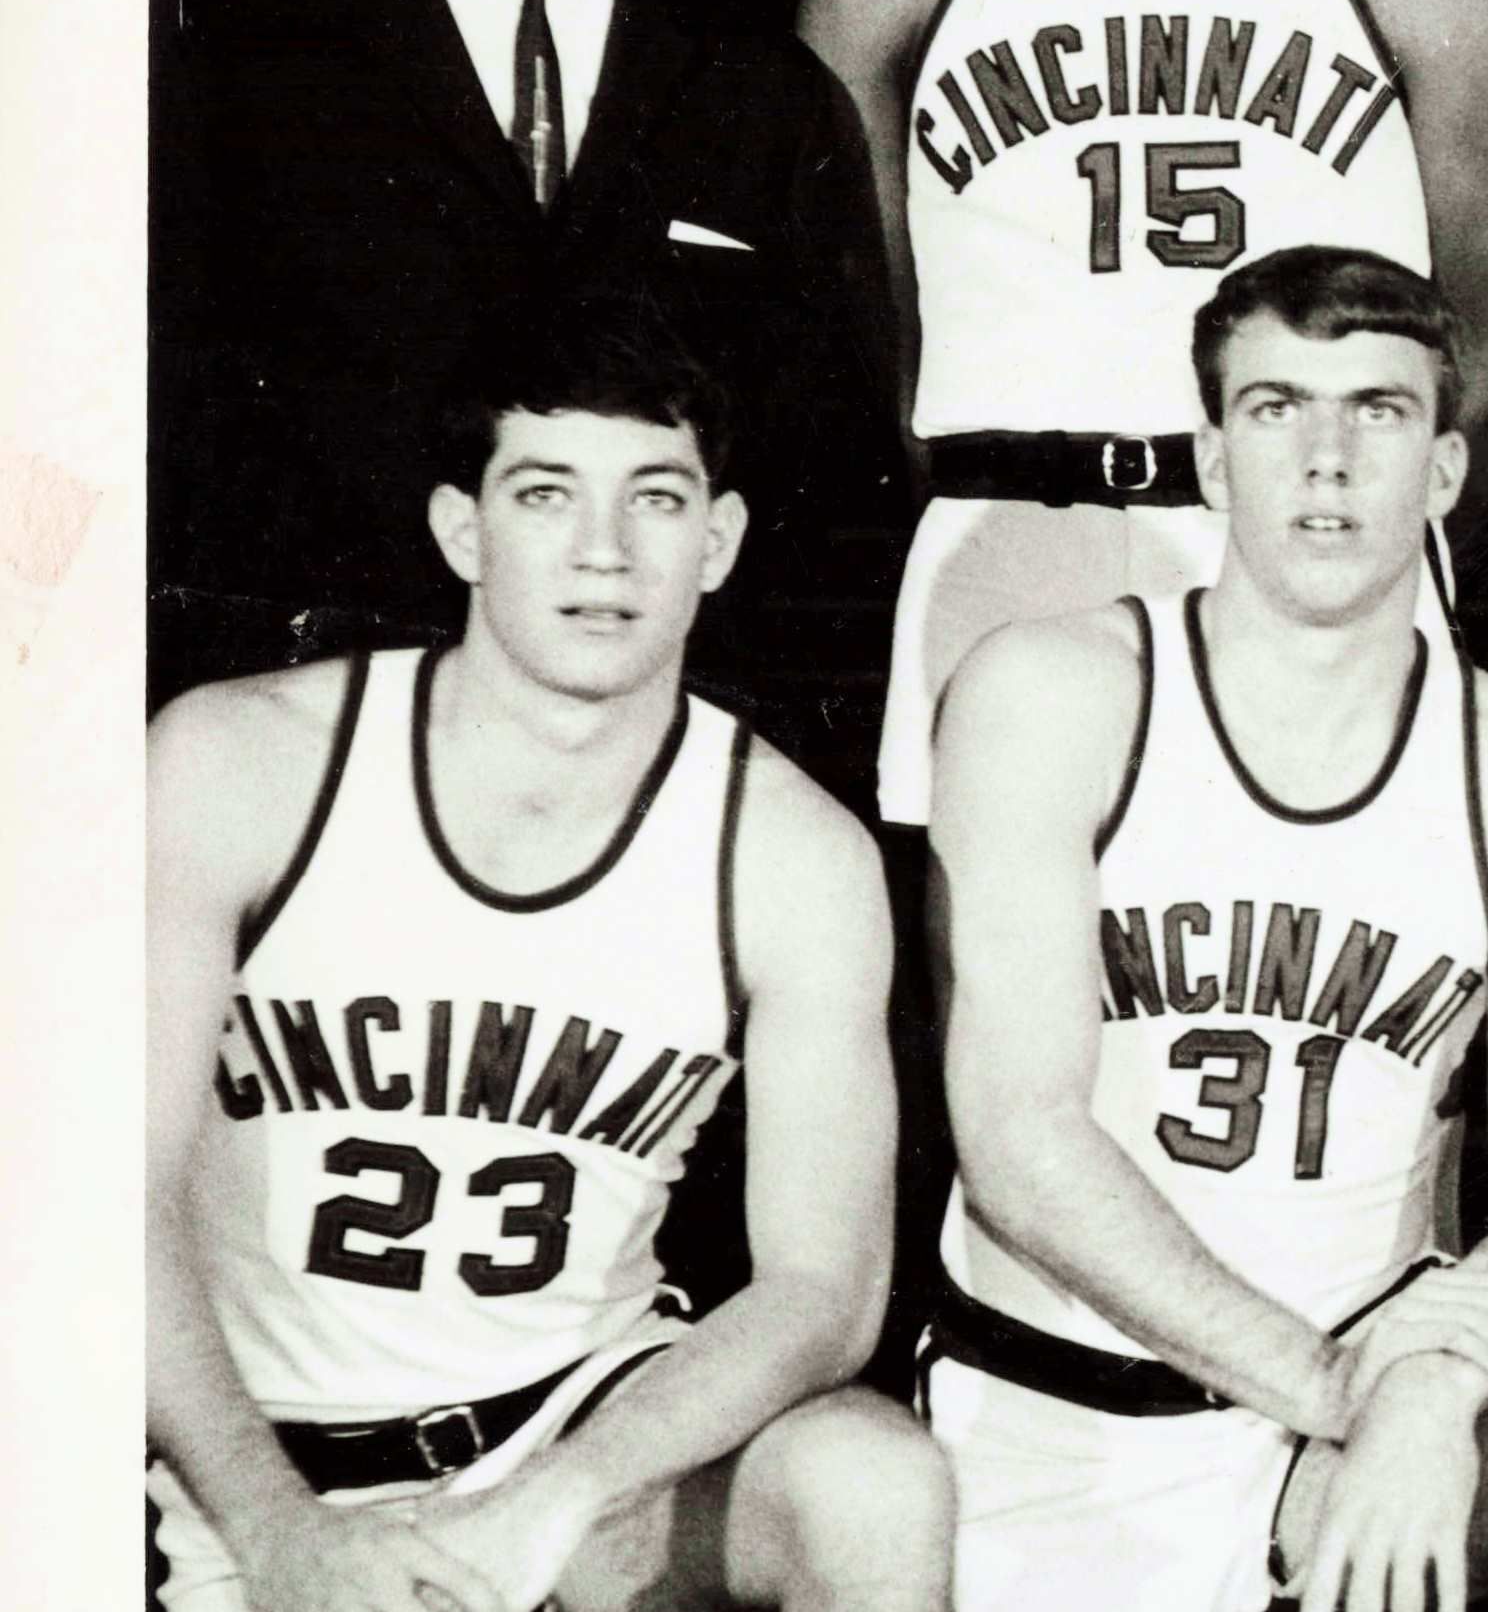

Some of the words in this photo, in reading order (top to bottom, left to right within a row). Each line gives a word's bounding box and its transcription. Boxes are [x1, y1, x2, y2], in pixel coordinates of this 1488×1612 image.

[916, 14, 1398, 194] CINCINNATI
[1076, 141, 1246, 273] 15
[1155, 1029, 1348, 1180] 31
[303, 1135, 577, 1297] 23
